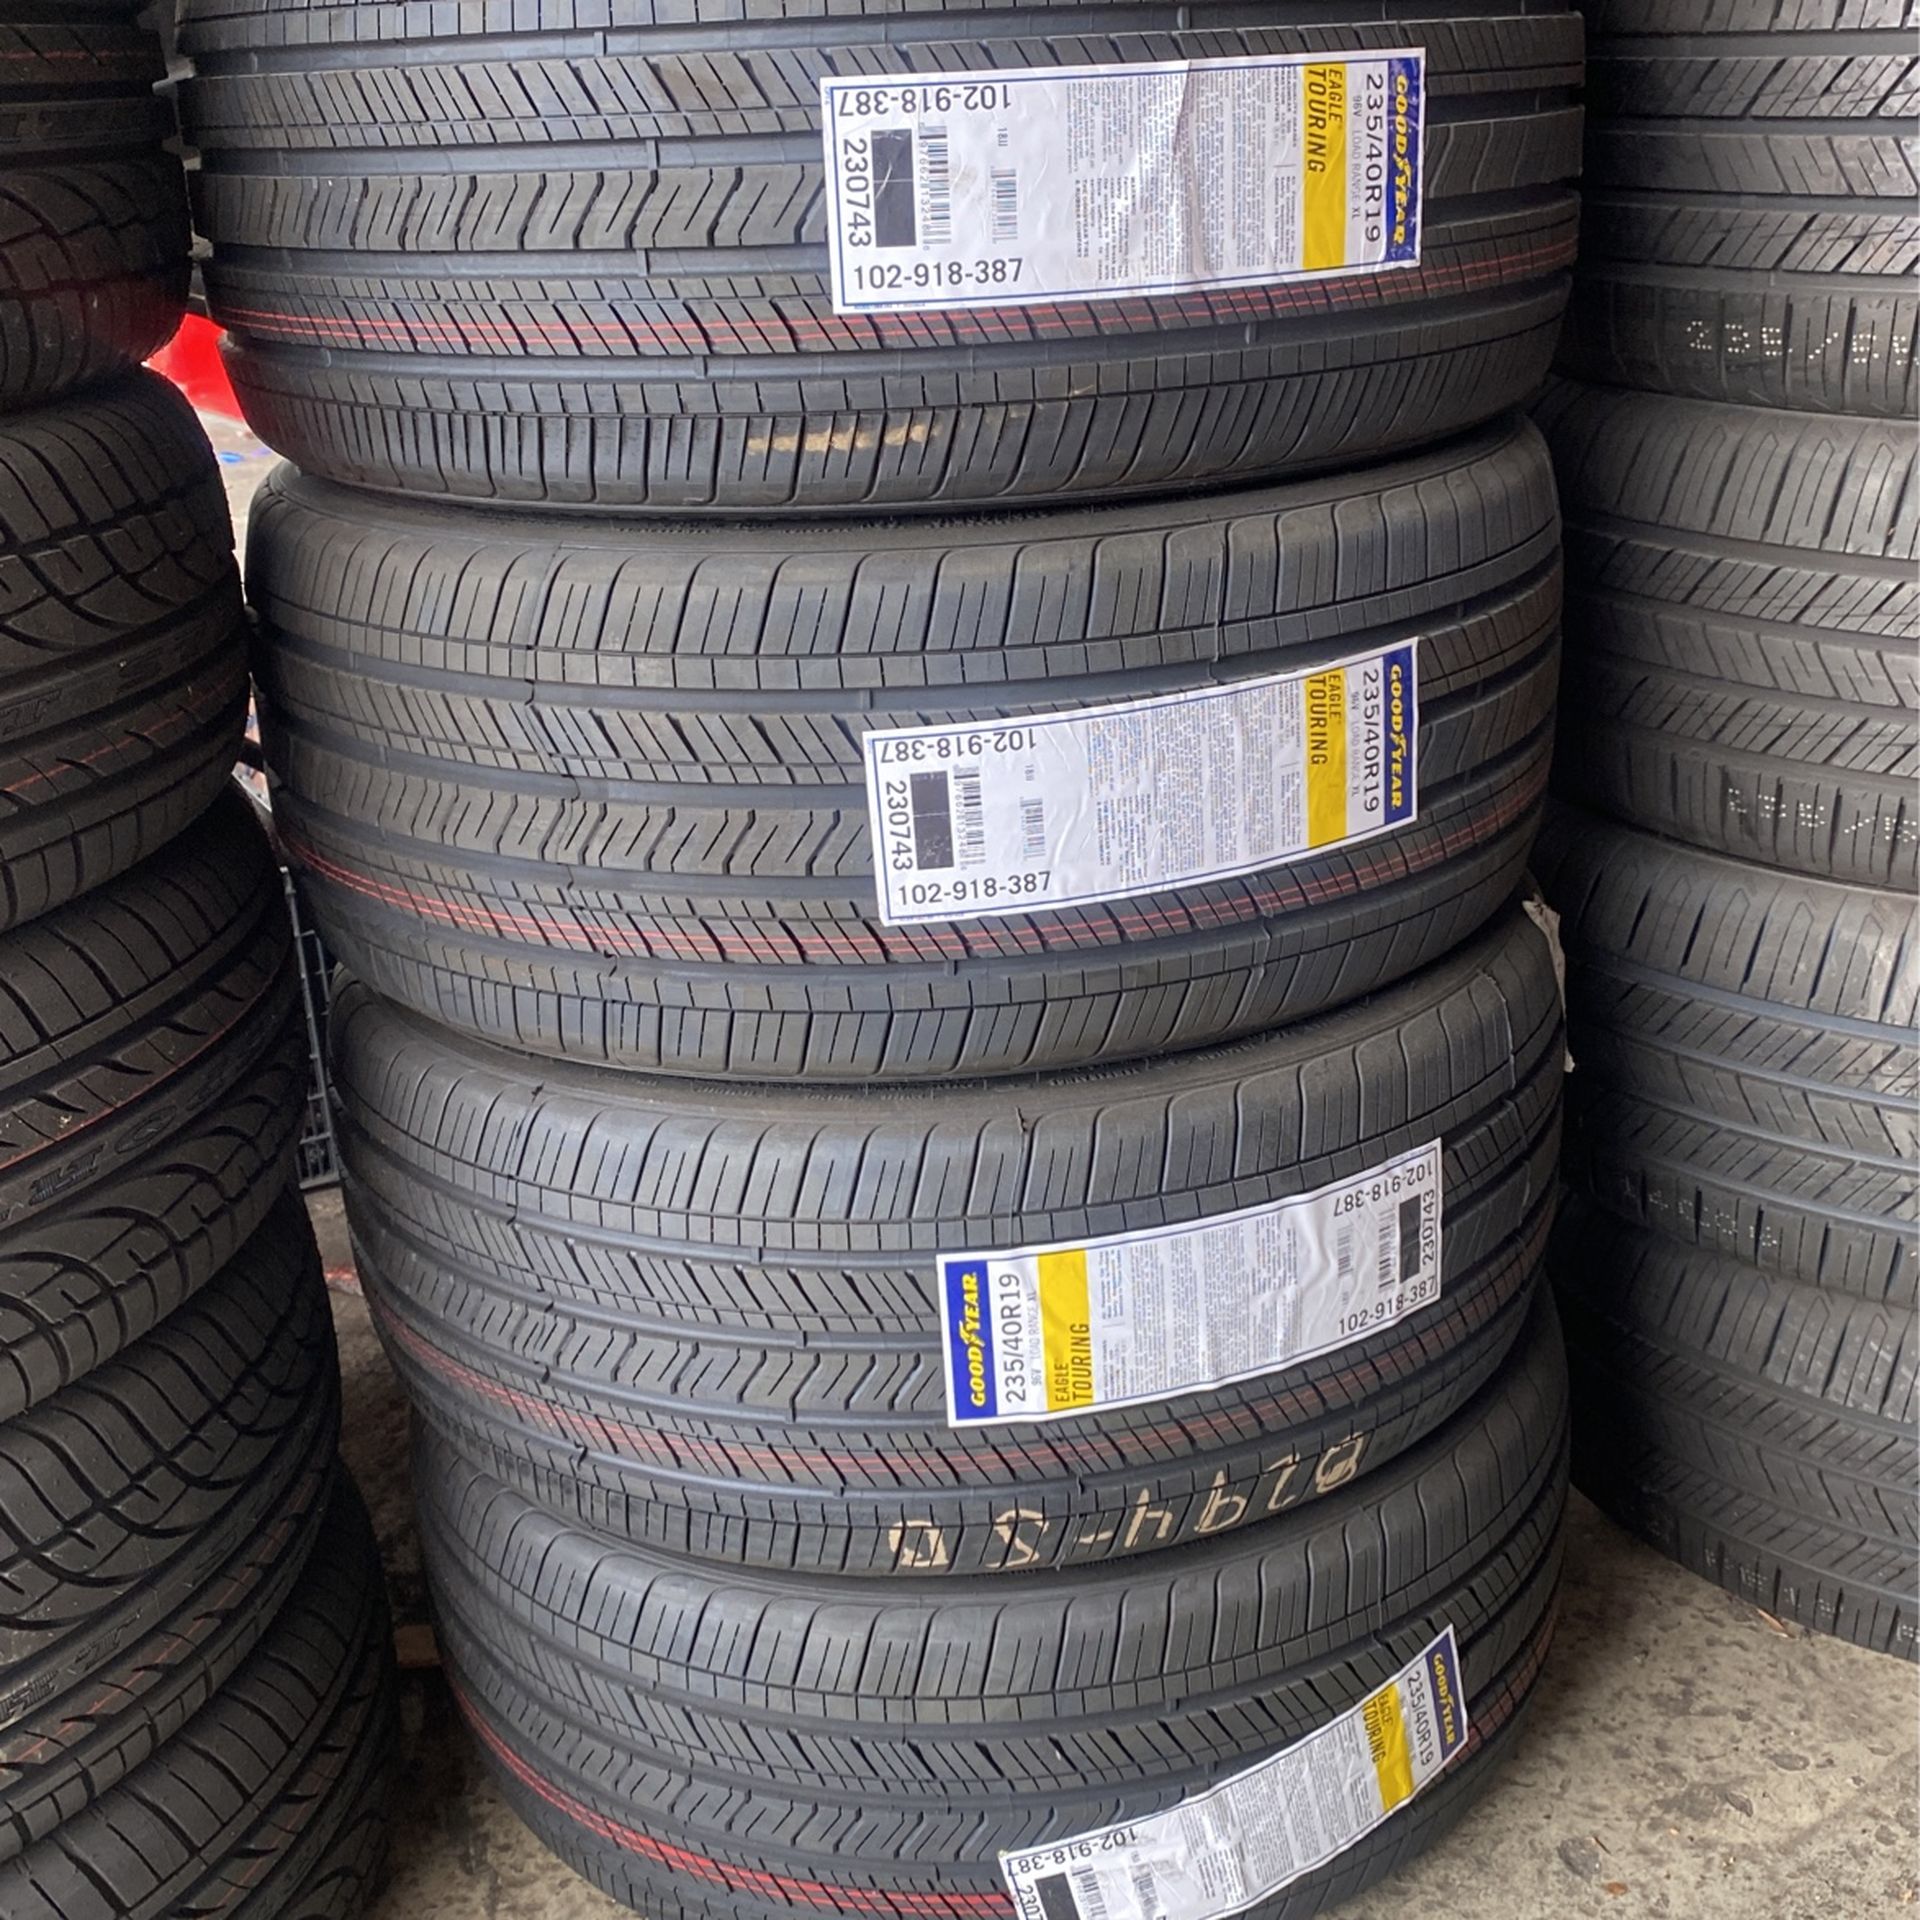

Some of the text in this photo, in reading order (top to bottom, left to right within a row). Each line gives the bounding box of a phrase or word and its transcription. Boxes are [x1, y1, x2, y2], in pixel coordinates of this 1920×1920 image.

[838, 83, 1012, 117] 102-918-387
[1307, 68, 1328, 174] TOURING
[1328, 68, 1344, 122] EAGLE
[843, 138, 872, 248] 230743
[1351, 95, 1362, 220] 96V LOAD RANGE XL
[1364, 73, 1384, 243] 235/40R19
[1392, 73, 1412, 246] GOODYEAR
[853, 258, 1023, 290] 102-918-387
[1309, 675, 1328, 766] TOURING
[1328, 673, 1342, 721] EAGLE
[1362, 668, 1382, 813] 235/40R19
[1390, 663, 1410, 811] GOODYEAR
[879, 728, 1037, 764] 102-918-387
[884, 780, 914, 871] 230743
[896, 870, 1052, 907] 102-918-387
[1332, 1157, 1434, 1218] 102-918-387
[1420, 1187, 1437, 1266] 230743
[957, 1271, 986, 1409] GOODYEAR
[997, 1273, 1027, 1404] 235/40R19
[1338, 1275, 1437, 1334] 102-918-387
[1052, 1357, 1072, 1405] EAGLE
[1069, 1321, 1094, 1405] TOURING
[1360, 1699, 1386, 1764] TOURING
[1377, 1690, 1395, 1727] EAGLE
[1404, 1669, 1435, 1767] 235/40R19
[1431, 1651, 1457, 1747] GOODYEAR
